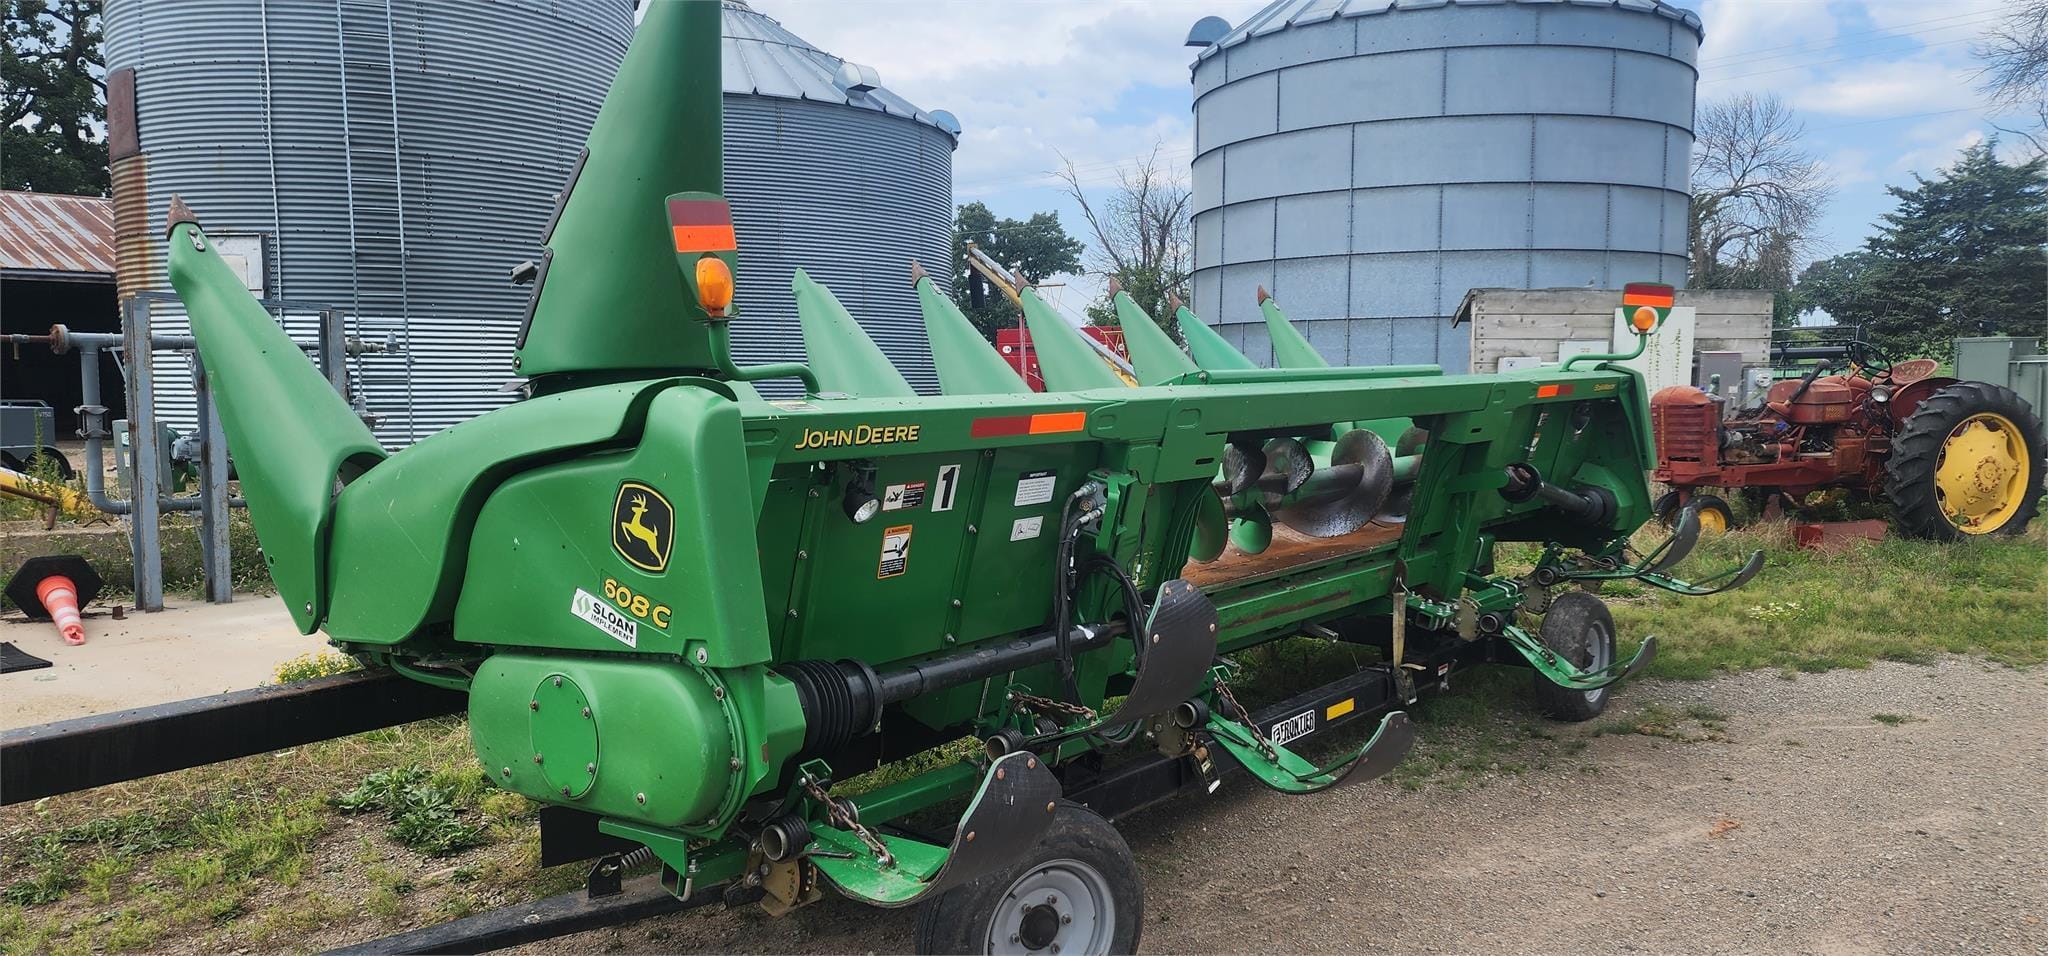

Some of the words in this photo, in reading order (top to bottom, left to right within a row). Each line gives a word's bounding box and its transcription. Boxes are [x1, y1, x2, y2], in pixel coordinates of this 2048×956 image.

[794, 428, 853, 451] JOHN
[855, 424, 920, 446] DEERE
[941, 467, 956, 509] 1
[590, 613, 634, 643] IMPLEMENT
[593, 602, 634, 636] SLOAN
[1280, 711, 1314, 741] FRONTIER
